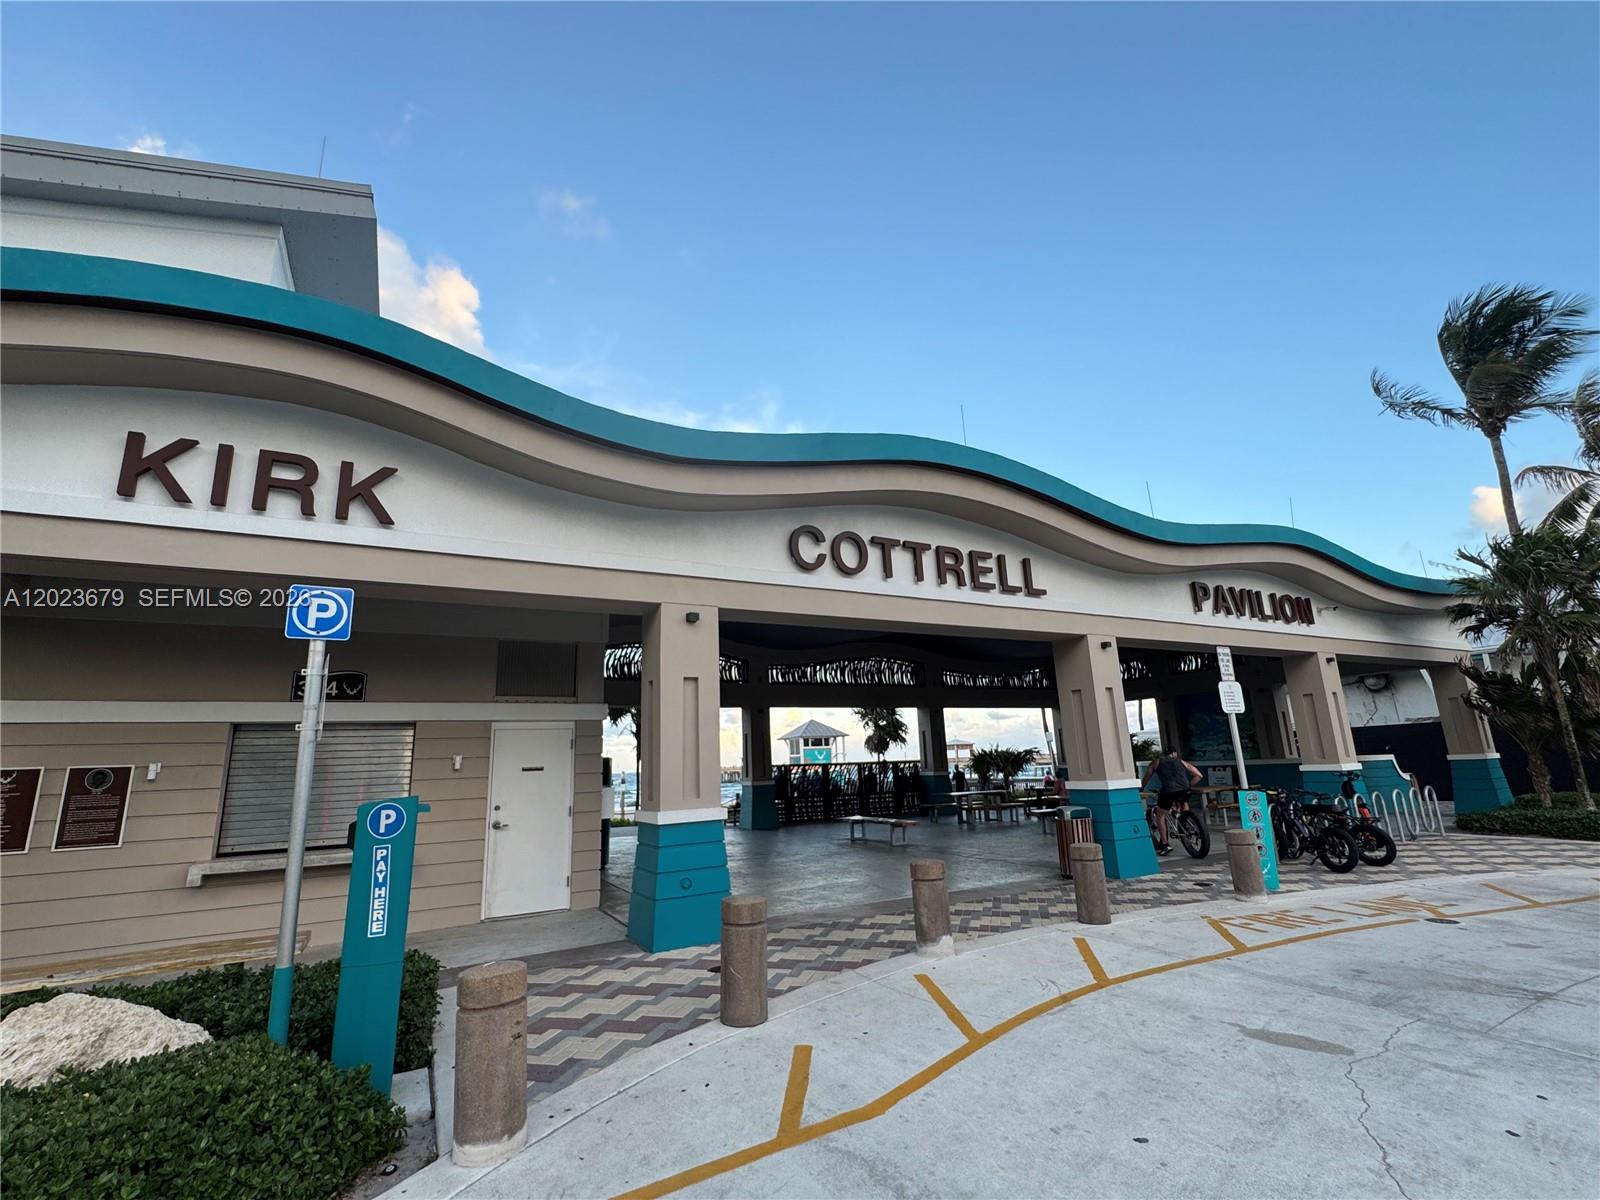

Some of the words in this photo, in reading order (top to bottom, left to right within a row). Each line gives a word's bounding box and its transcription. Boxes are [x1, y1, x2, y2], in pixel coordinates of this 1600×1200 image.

[116, 430, 399, 526] KIRK
[789, 524, 1047, 598] COTTRELL
[1190, 581, 1316, 625] PAVILION
[306, 597, 338, 629] P
[379, 809, 397, 834] P
[375, 849, 388, 883] PAY
[371, 886, 386, 933] HERE
